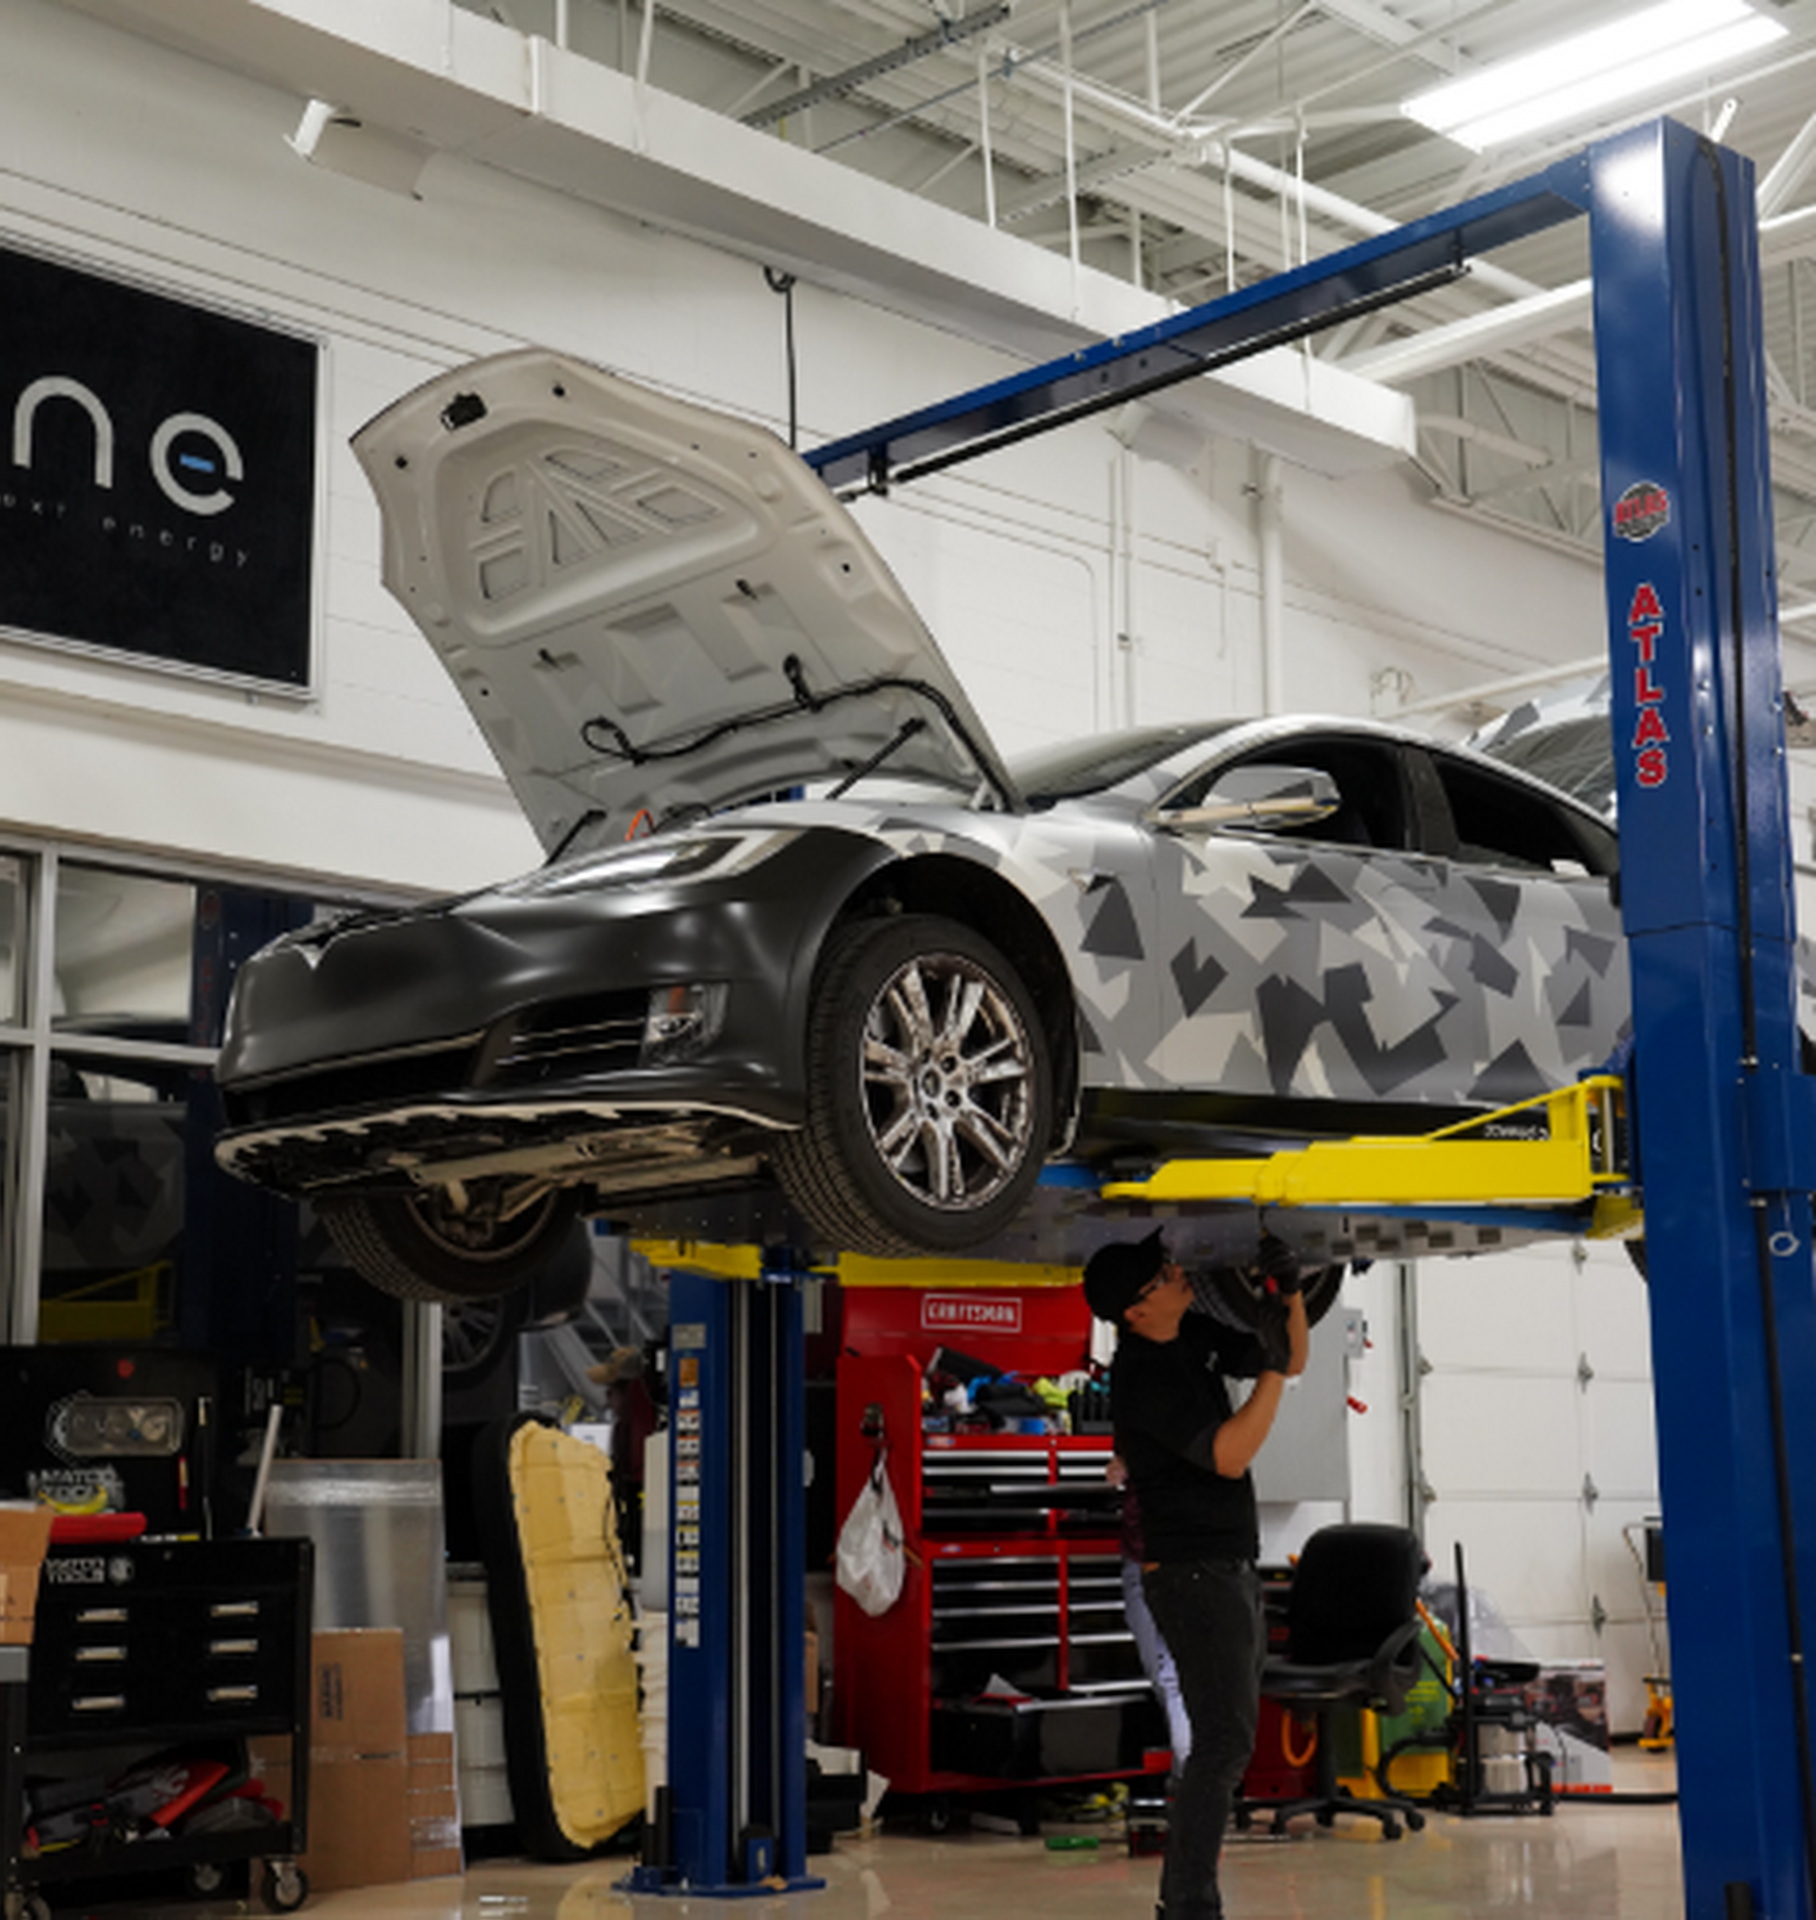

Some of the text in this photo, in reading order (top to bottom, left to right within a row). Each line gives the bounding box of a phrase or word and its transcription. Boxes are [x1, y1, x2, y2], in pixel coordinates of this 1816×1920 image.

[0, 493, 248, 567] ext energy
[1614, 489, 1668, 524] ATLAS
[1628, 583, 1670, 788] ATLAS
[928, 1301, 1015, 1323] CRAFTSMAN
